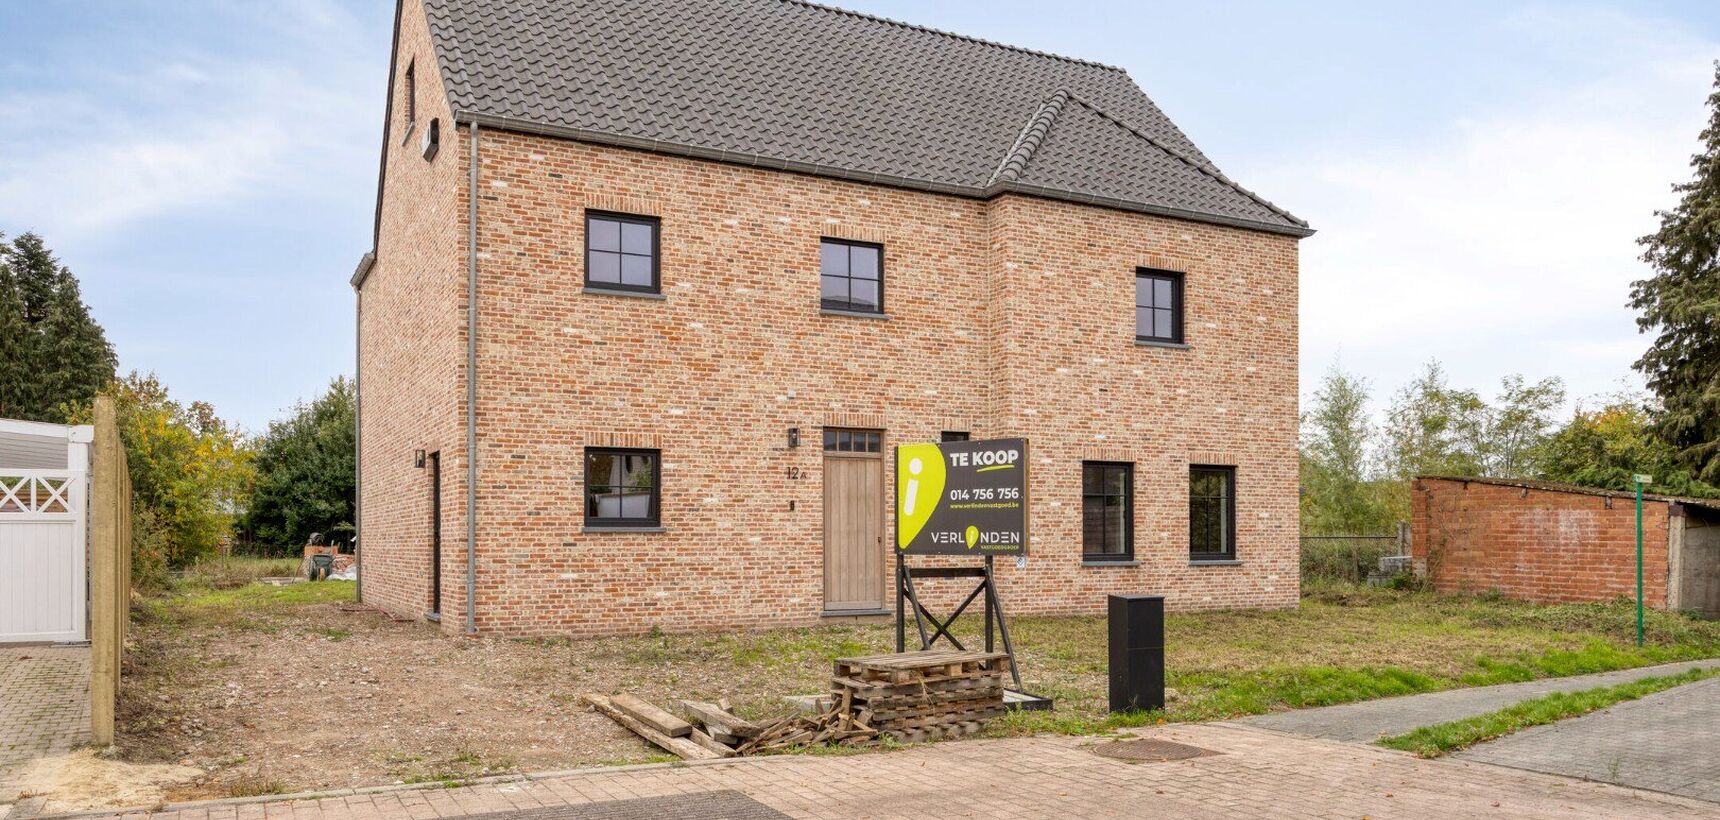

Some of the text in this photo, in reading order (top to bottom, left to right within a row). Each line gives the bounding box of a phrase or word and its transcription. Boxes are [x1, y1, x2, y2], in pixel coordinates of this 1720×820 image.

[950, 449, 1019, 467] TE KOOP
[950, 487, 1019, 501] 014 756 756
